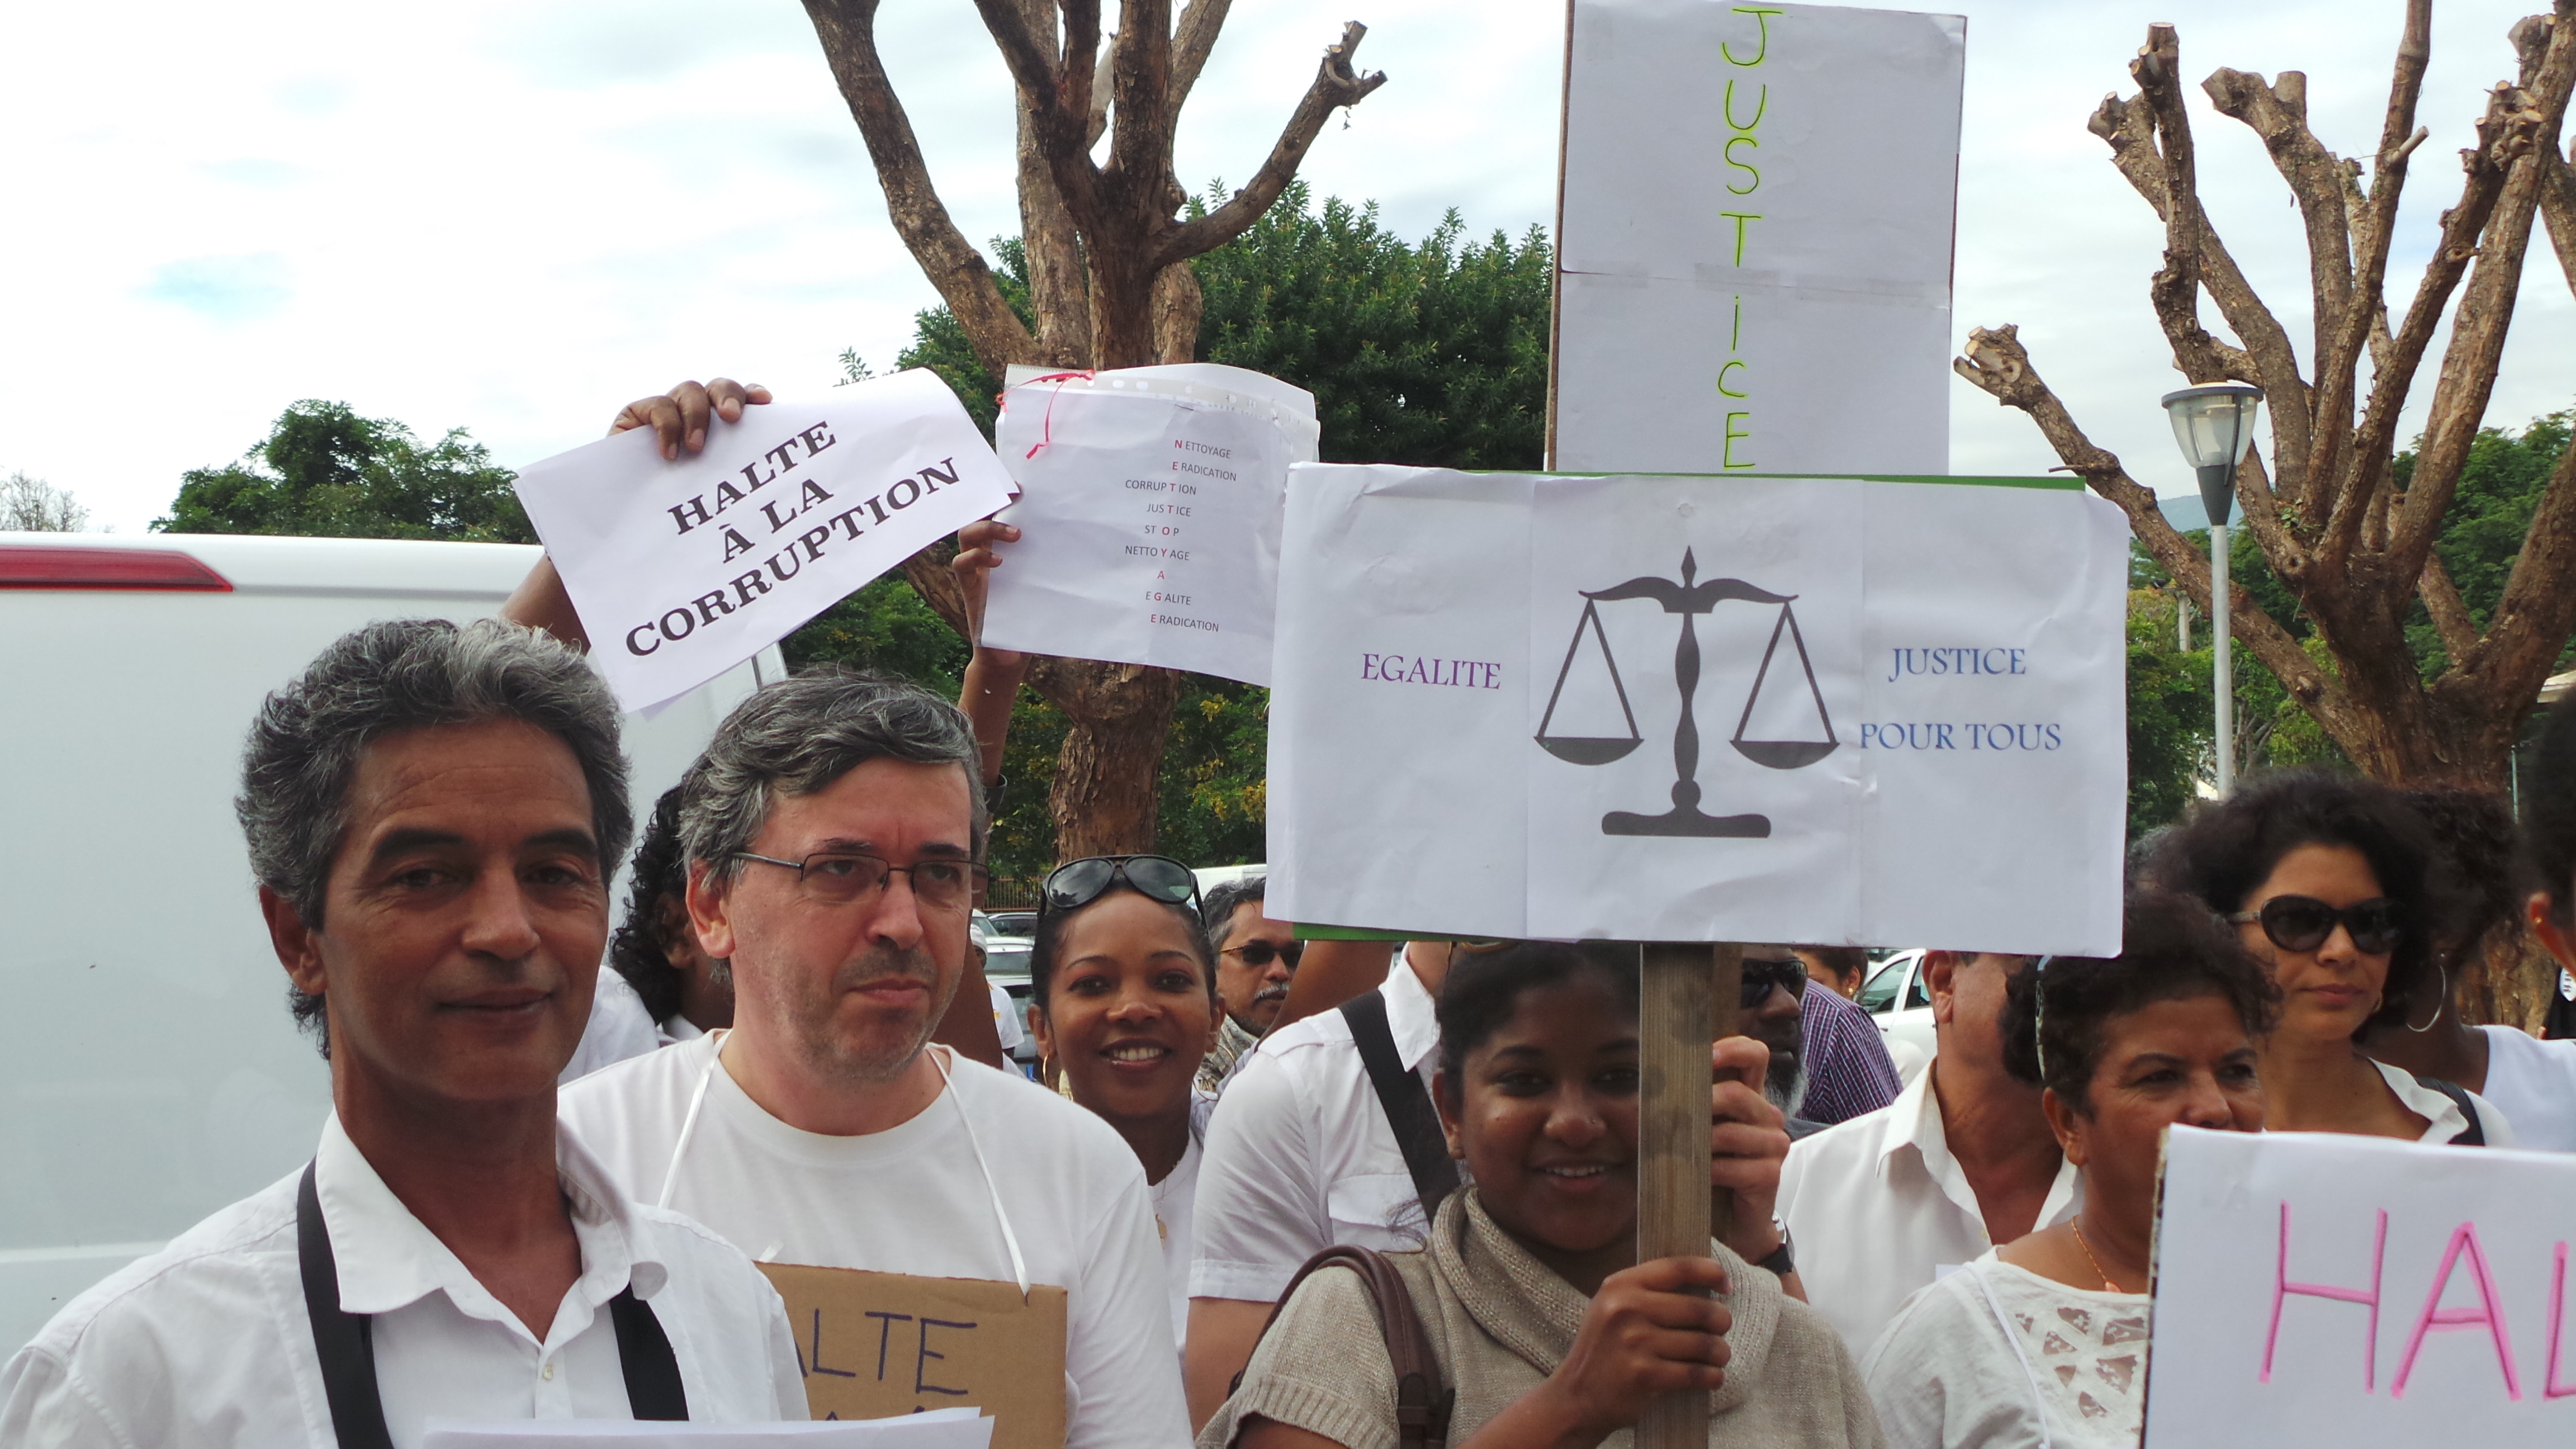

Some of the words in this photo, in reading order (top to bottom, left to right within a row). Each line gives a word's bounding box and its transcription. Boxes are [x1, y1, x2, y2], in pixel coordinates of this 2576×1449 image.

[667, 420, 837, 535] HALTE
[719, 523, 756, 564] À
[760, 479, 834, 534] LA
[626, 457, 960, 657] CORRUPTION
[1157, 571, 1164, 580] A
[1361, 653, 1501, 690] EGALITE
[1888, 647, 2026, 683] JUSTICE
[1860, 723, 1957, 750] POUR
[1965, 723, 2062, 750] TOUS
[794, 1308, 978, 1394] LTE
